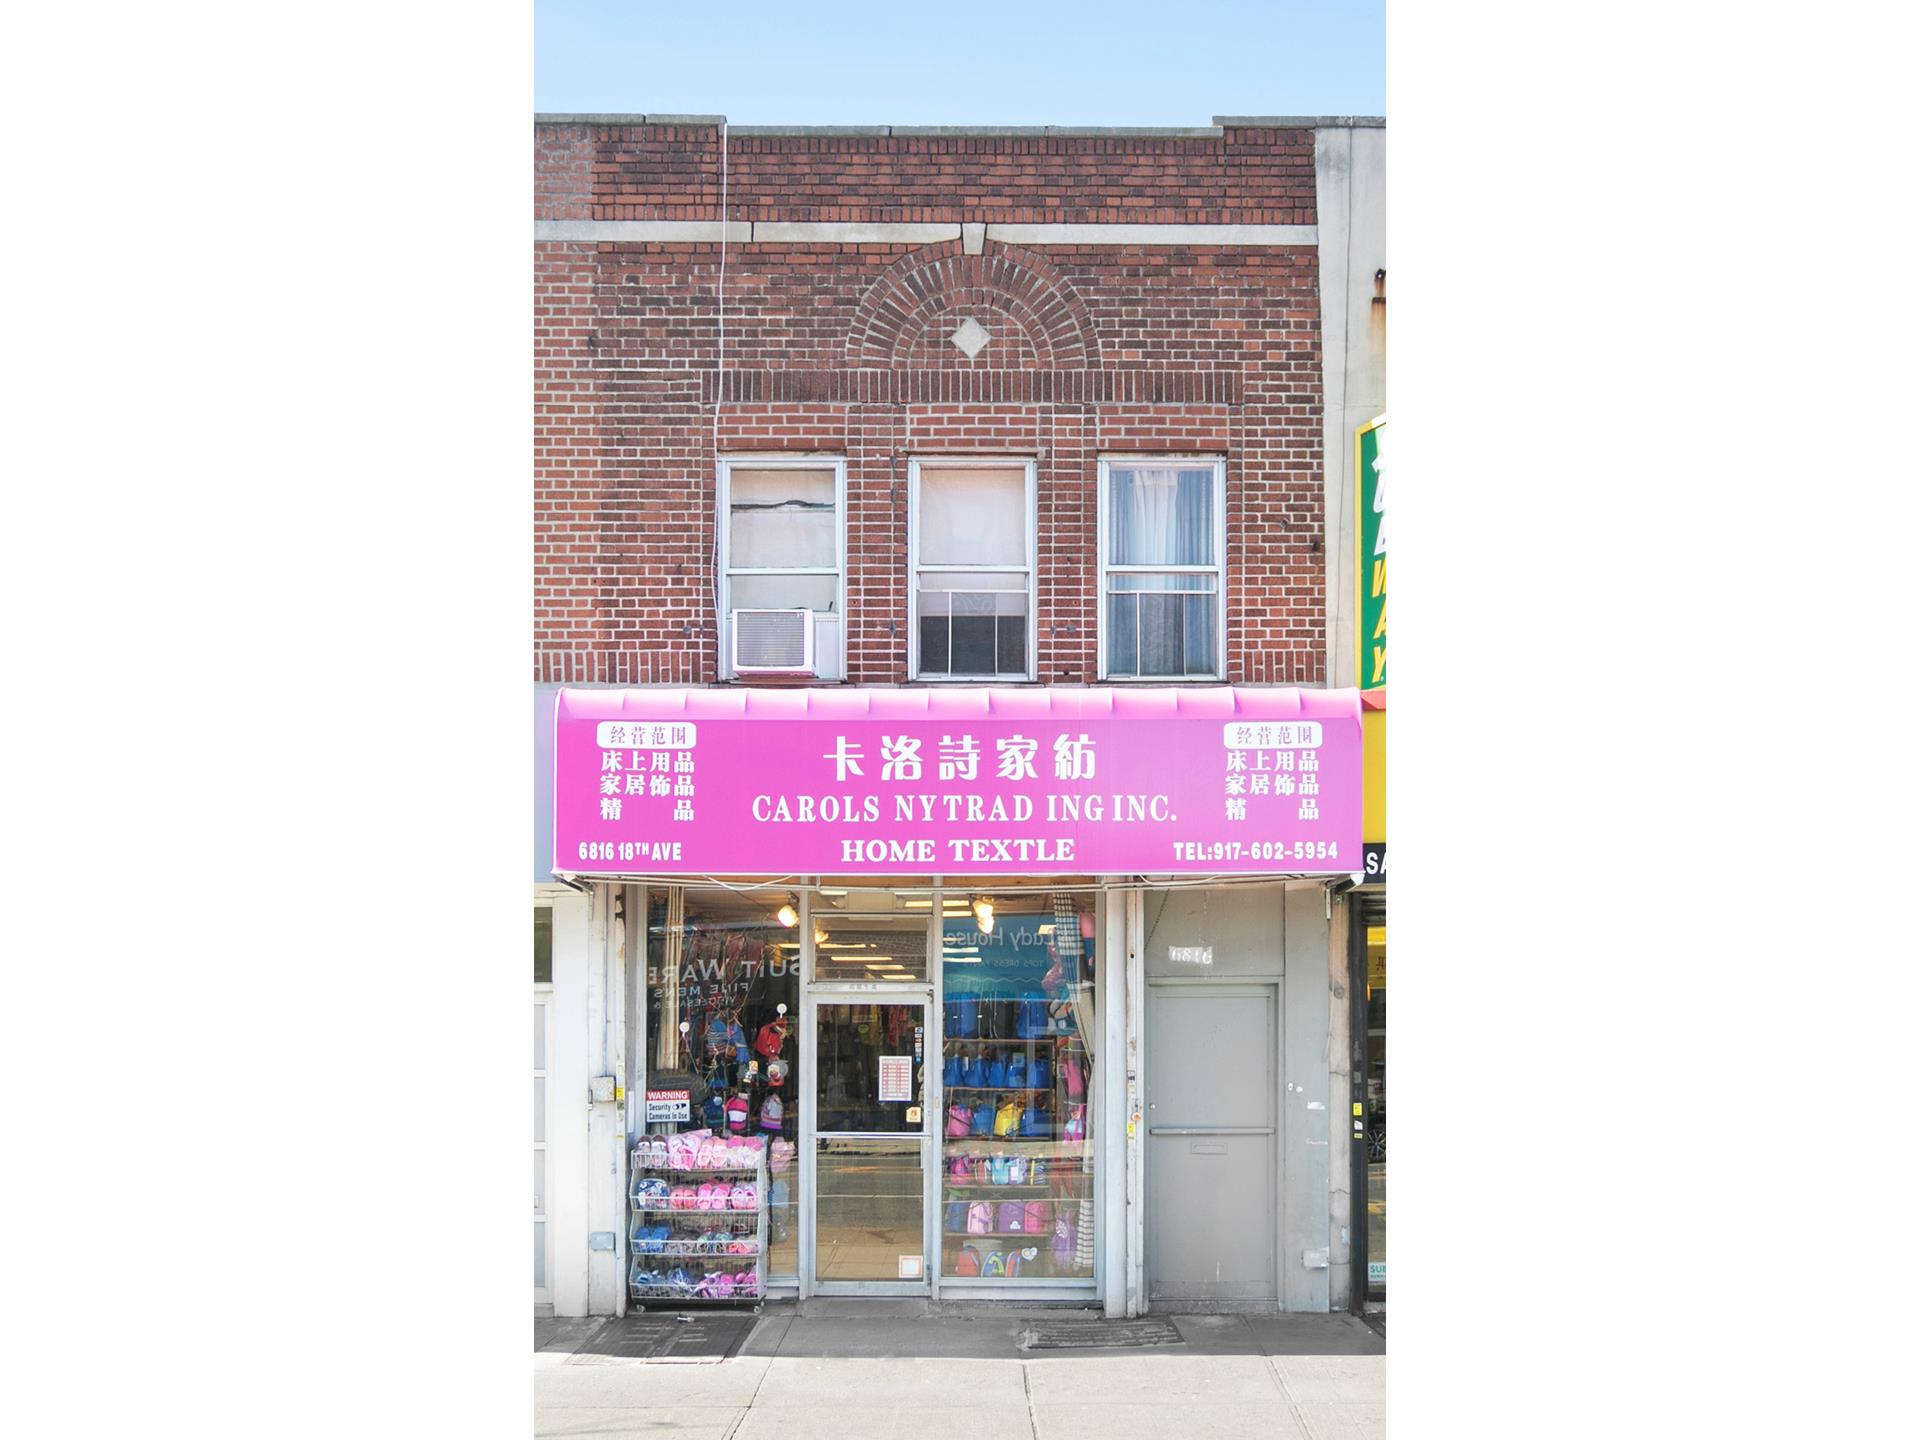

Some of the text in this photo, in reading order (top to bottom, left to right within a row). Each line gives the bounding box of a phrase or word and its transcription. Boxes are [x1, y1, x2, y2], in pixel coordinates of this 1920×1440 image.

[610, 725, 686, 745] 经营范围
[1237, 725, 1312, 745] 经营范围
[600, 749, 695, 773] 床上用品
[823, 734, 1097, 782] 卡洛詩家紡
[1225, 749, 1320, 772] 床上用品
[599, 773, 695, 797] 家居饰品
[1224, 773, 1320, 796] 家居饰品
[752, 795, 880, 822] CAROLS
[578, 841, 682, 861] 6816 18TH AVE
[841, 838, 1075, 863] HOME TEXTLE
[1173, 841, 1339, 861] TEL:917-602-5954
[647, 1091, 689, 1100] WARNING
[648, 1103, 671, 1112] Security
[648, 1112, 671, 1121] Cameras
